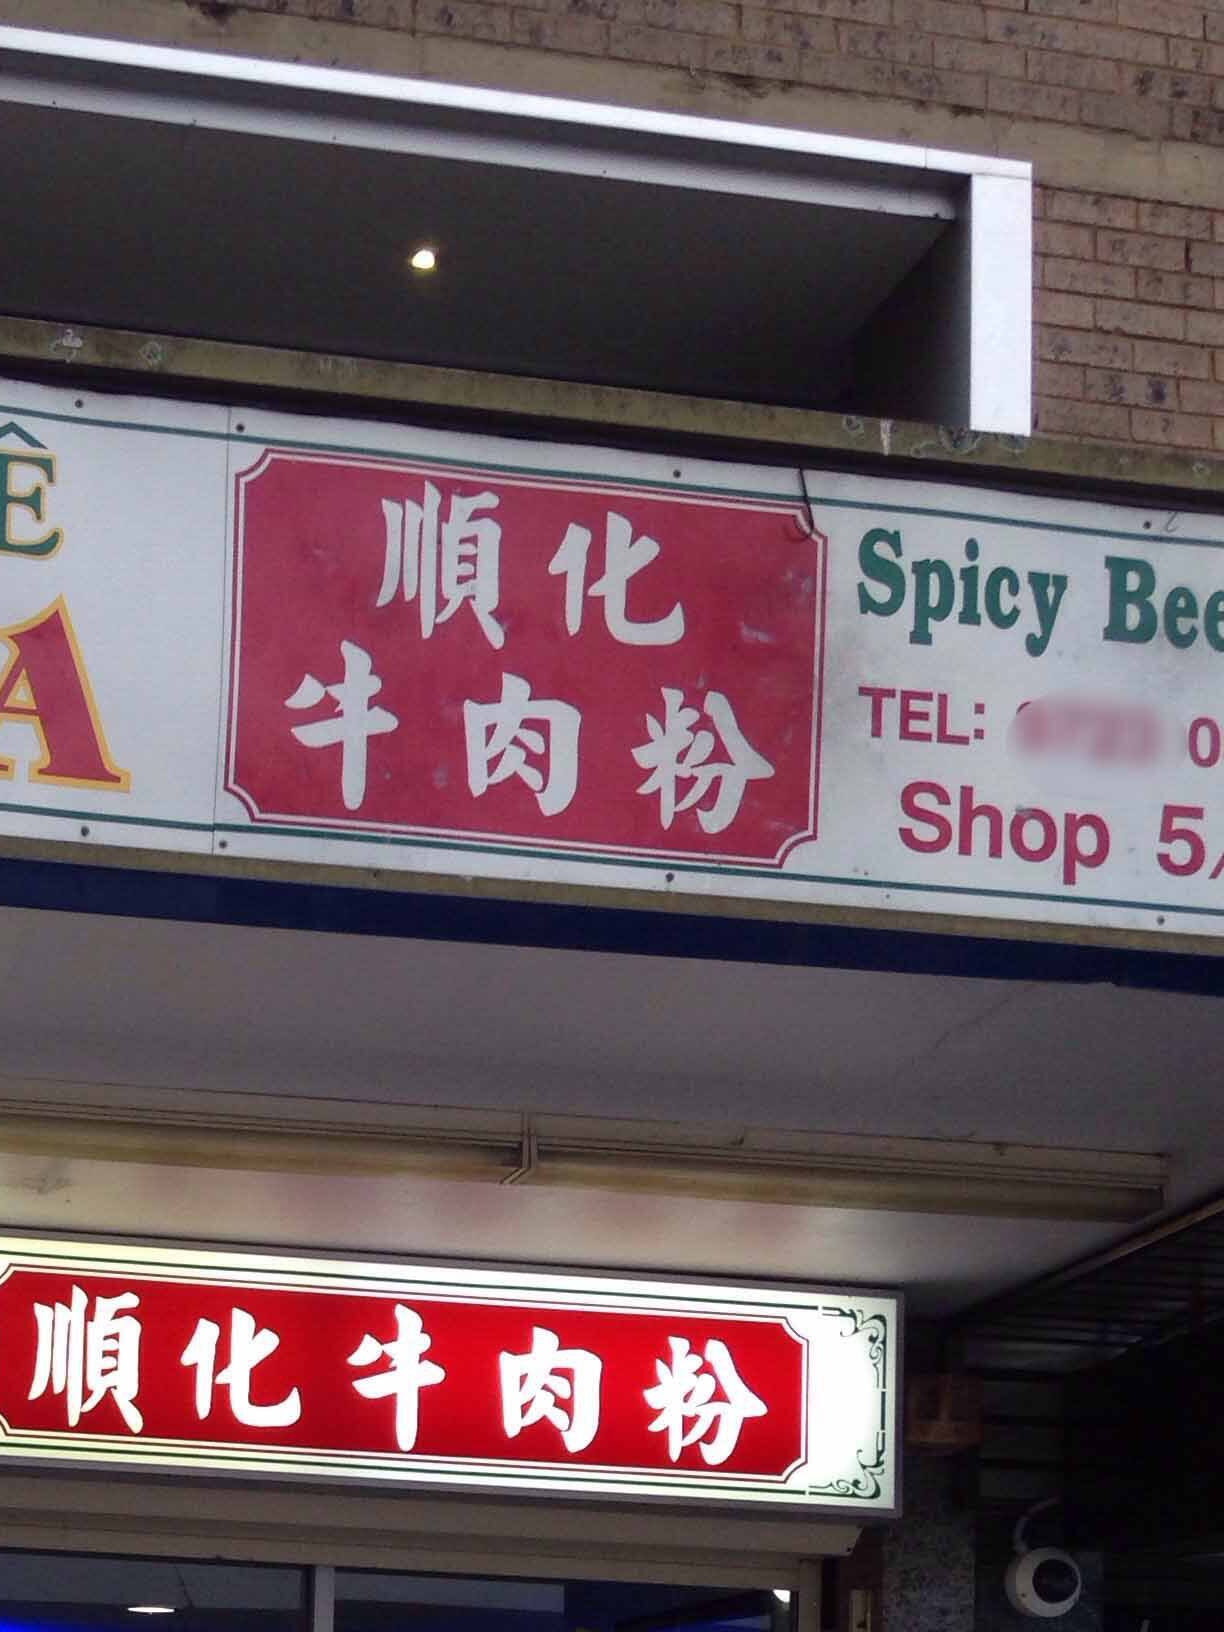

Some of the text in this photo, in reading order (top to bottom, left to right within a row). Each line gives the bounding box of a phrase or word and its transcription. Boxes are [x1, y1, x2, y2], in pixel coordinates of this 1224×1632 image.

[376, 480, 686, 650] 順化
[858, 527, 1068, 657] Spicy
[285, 640, 774, 834] 牛肉粉
[858, 686, 985, 745] TEL:
[898, 780, 1111, 885] Shop
[27, 1283, 769, 1466] 順化牛肉粉
